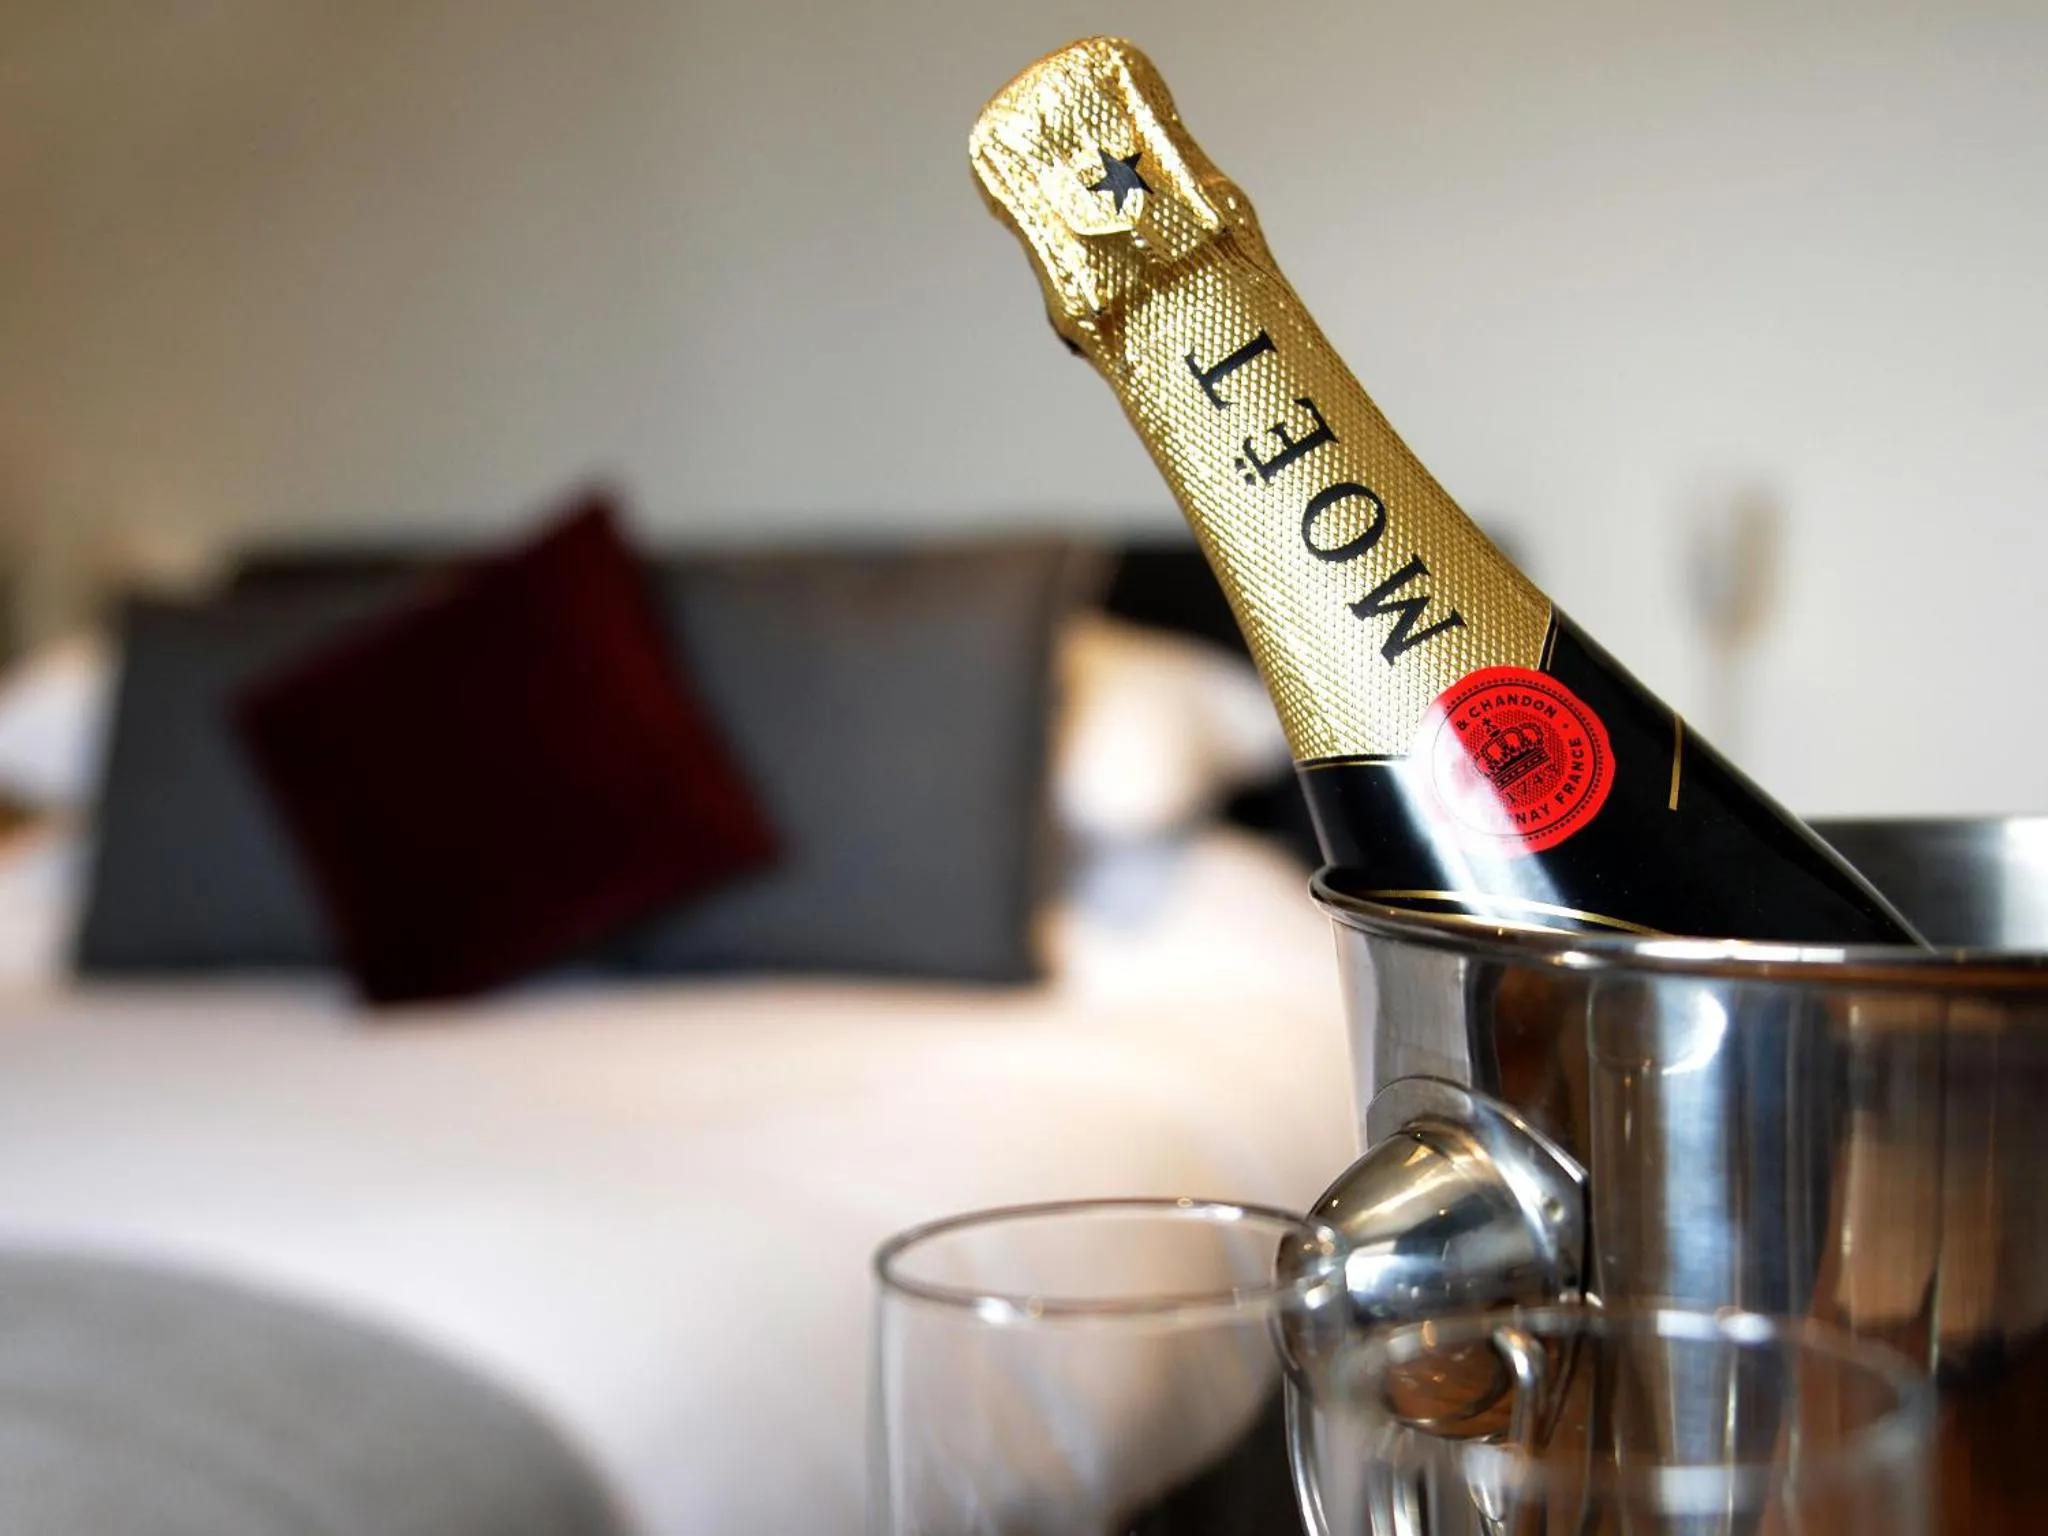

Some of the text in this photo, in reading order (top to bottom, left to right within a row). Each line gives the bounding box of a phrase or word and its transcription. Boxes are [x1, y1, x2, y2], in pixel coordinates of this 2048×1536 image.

[1184, 328, 1467, 667] MOËT
[1455, 693, 1558, 731] & CHANDON
[1554, 737, 1585, 805] FRANCE
